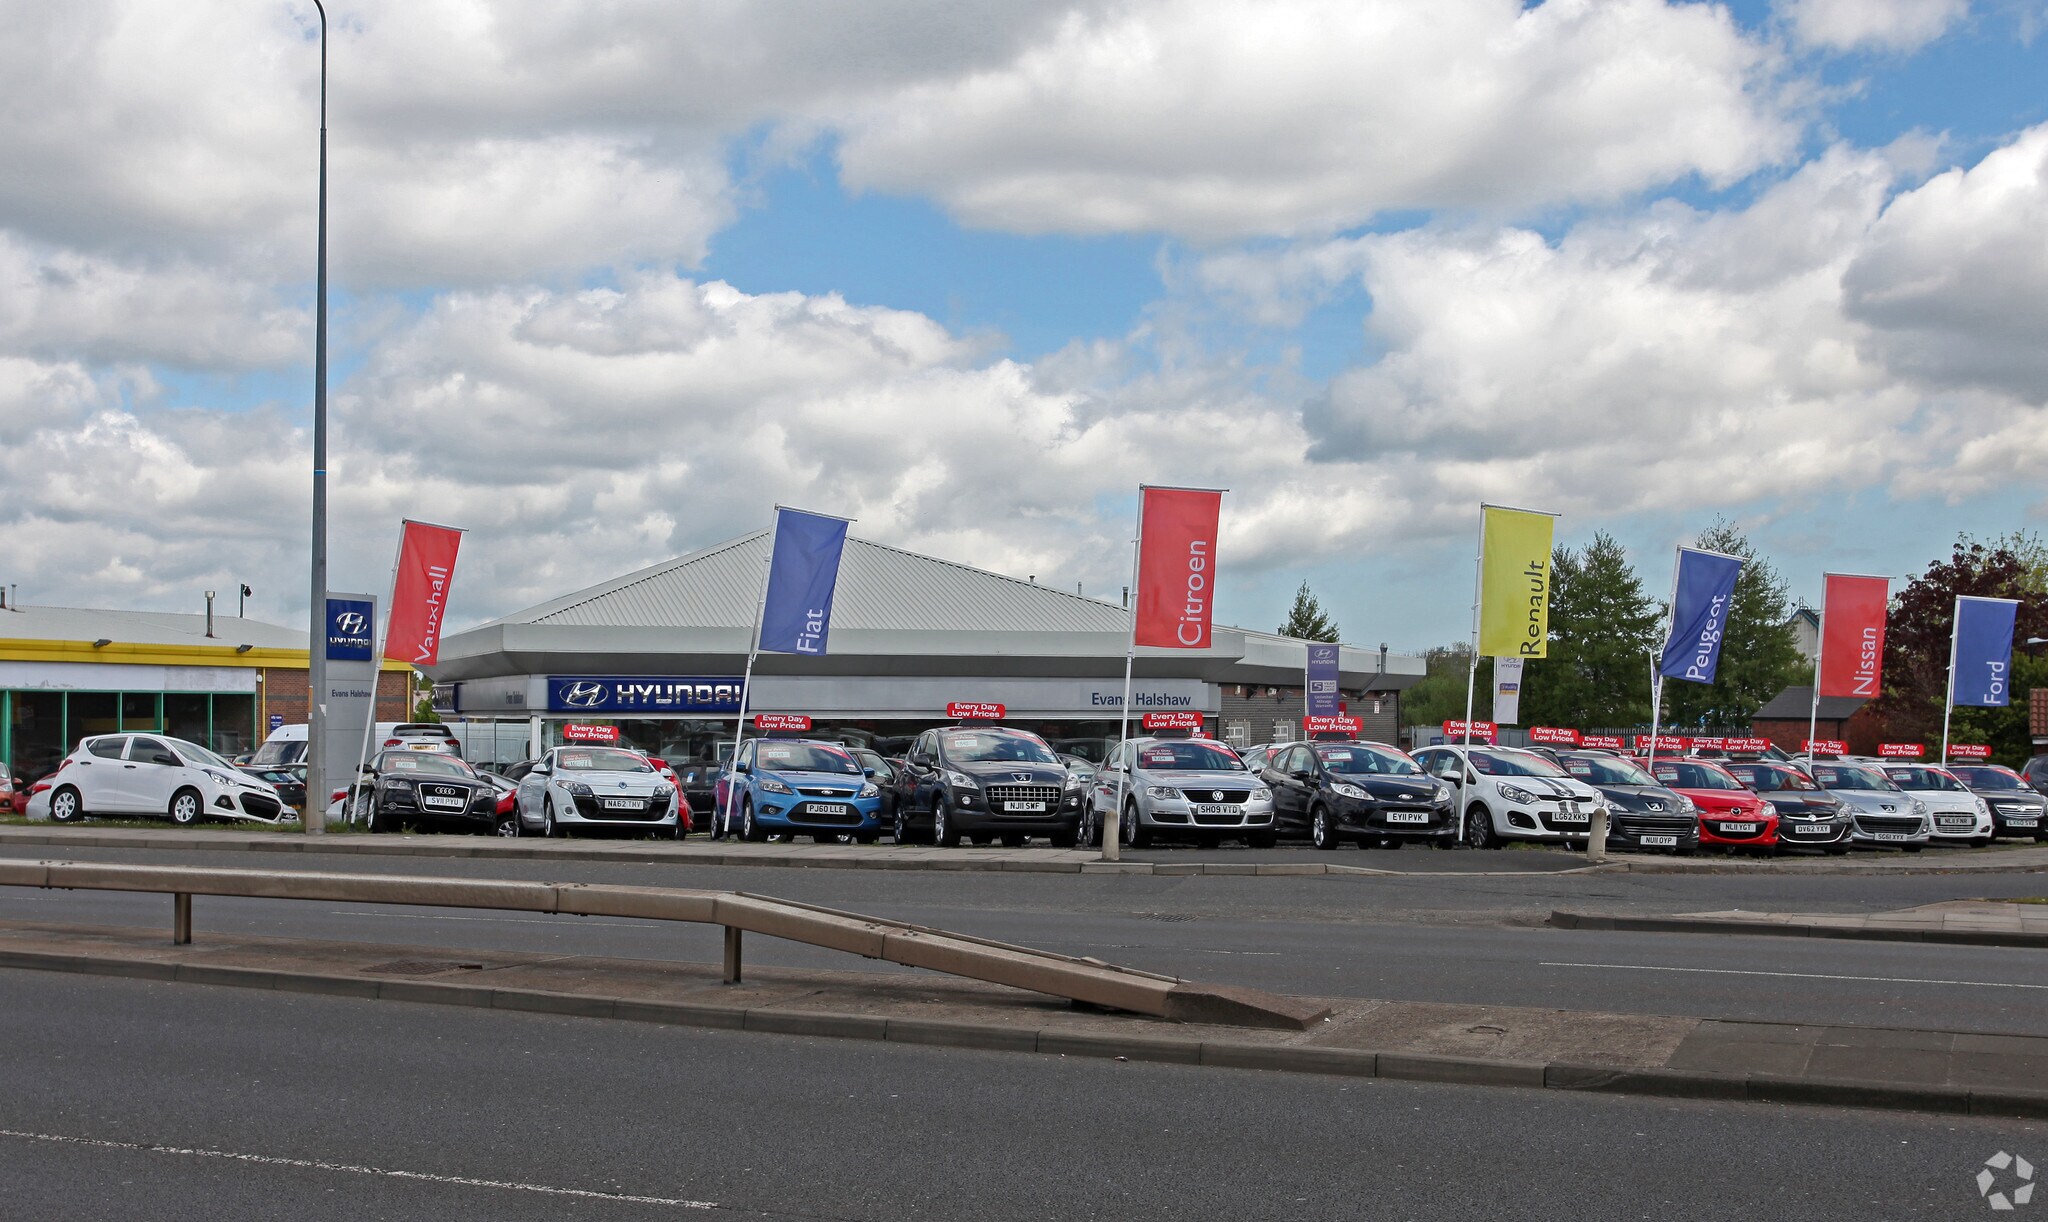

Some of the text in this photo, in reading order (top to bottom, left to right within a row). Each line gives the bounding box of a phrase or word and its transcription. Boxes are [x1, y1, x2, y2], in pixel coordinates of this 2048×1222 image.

[1177, 540, 1207, 646] Citroen
[414, 565, 448, 662] Vauxhall
[1519, 560, 1545, 655] Renault
[796, 608, 823, 652] Fiat
[1685, 594, 1726, 680] Peugeot
[1853, 627, 1877, 695] Nissan
[1983, 661, 2005, 704] Ford
[332, 689, 349, 697] Evans
[616, 684, 740, 704] HYUNDAI
[1136, 693, 1191, 706] Halshaw
[954, 703, 998, 712] Every Day
[762, 714, 786, 723] Every
[1178, 712, 1195, 720] Day
[571, 725, 611, 734] Every Day
[1643, 736, 1663, 744] Evry
[1828, 742, 1842, 750] Day
